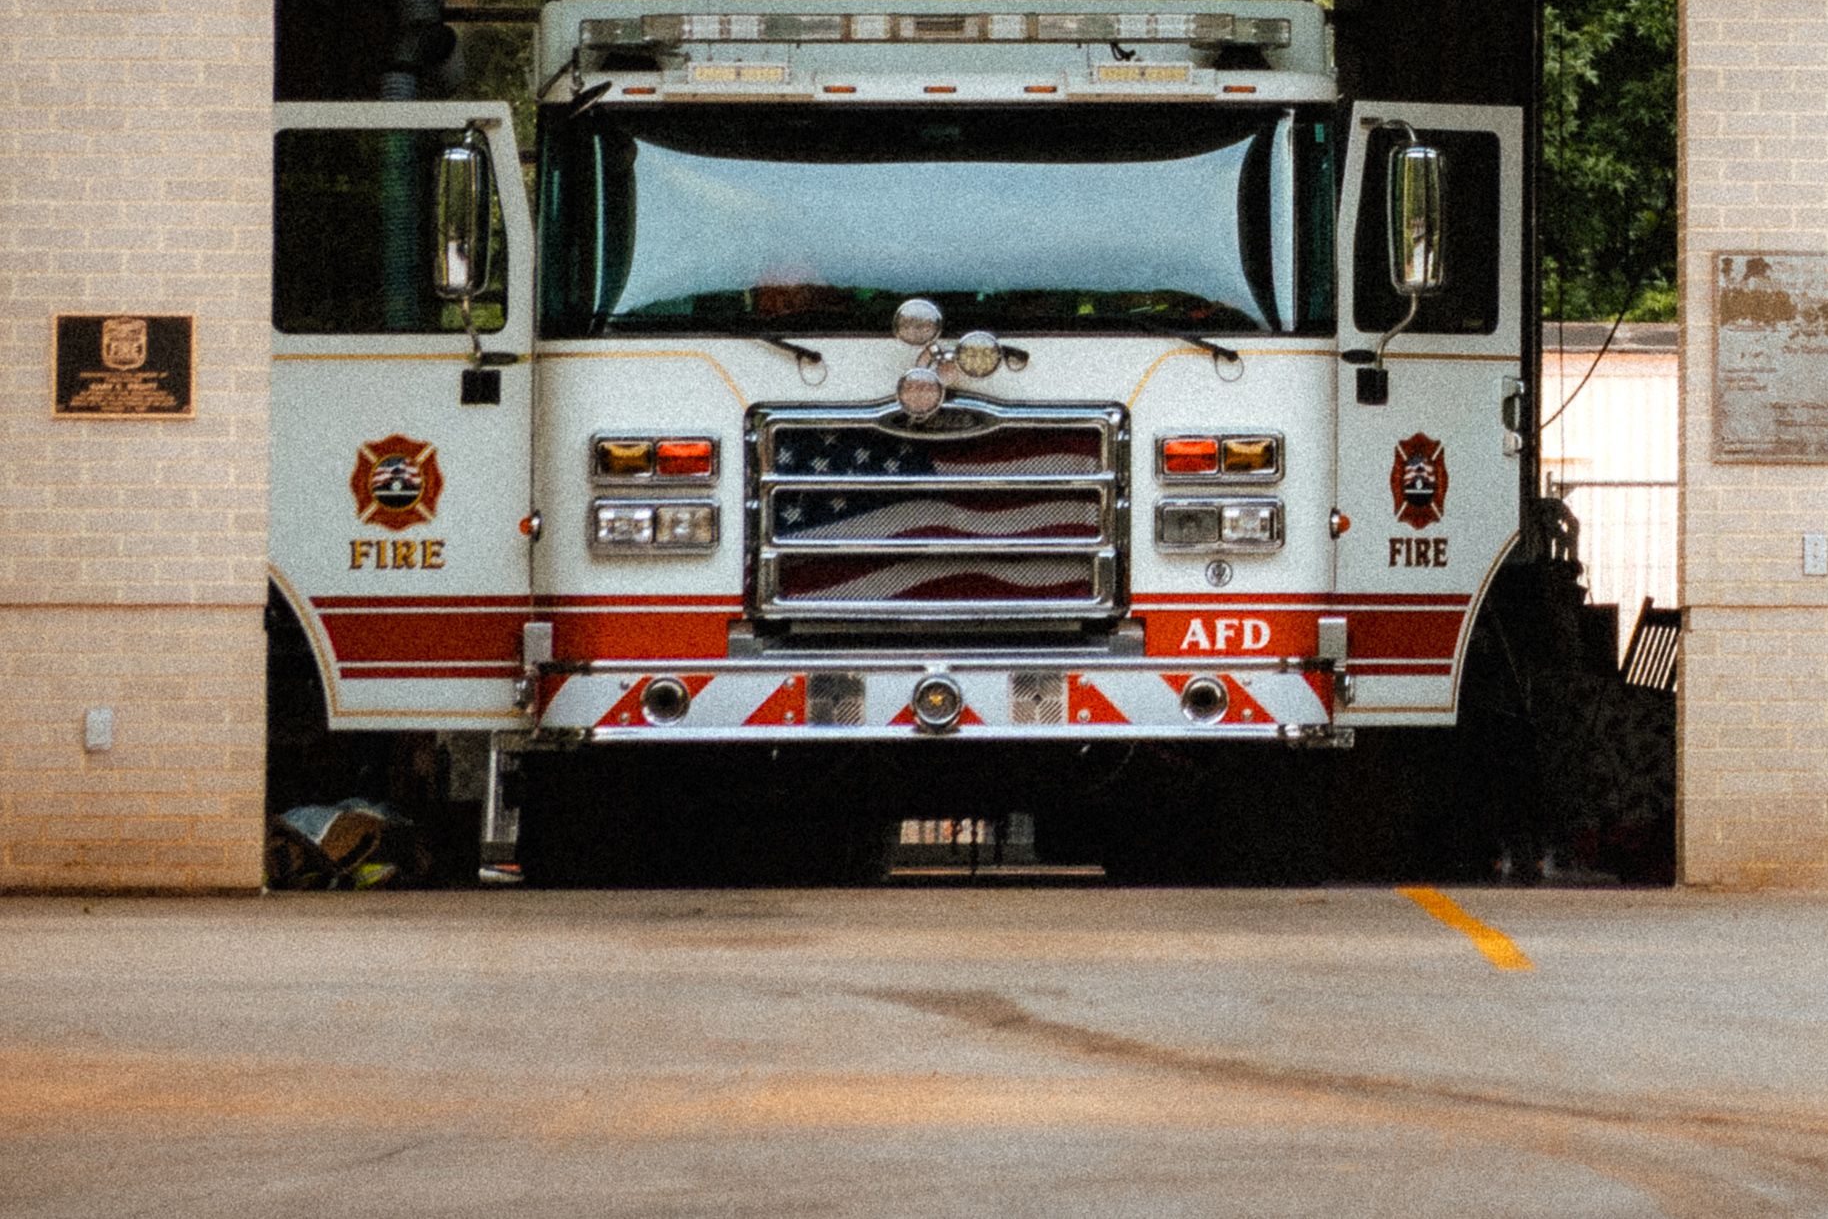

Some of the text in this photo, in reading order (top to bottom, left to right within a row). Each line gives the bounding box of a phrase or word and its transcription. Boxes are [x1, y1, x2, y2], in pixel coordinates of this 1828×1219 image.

[349, 539, 446, 570] FIRE
[1388, 537, 1449, 568] FIRE
[1180, 618, 1272, 650] AFD
